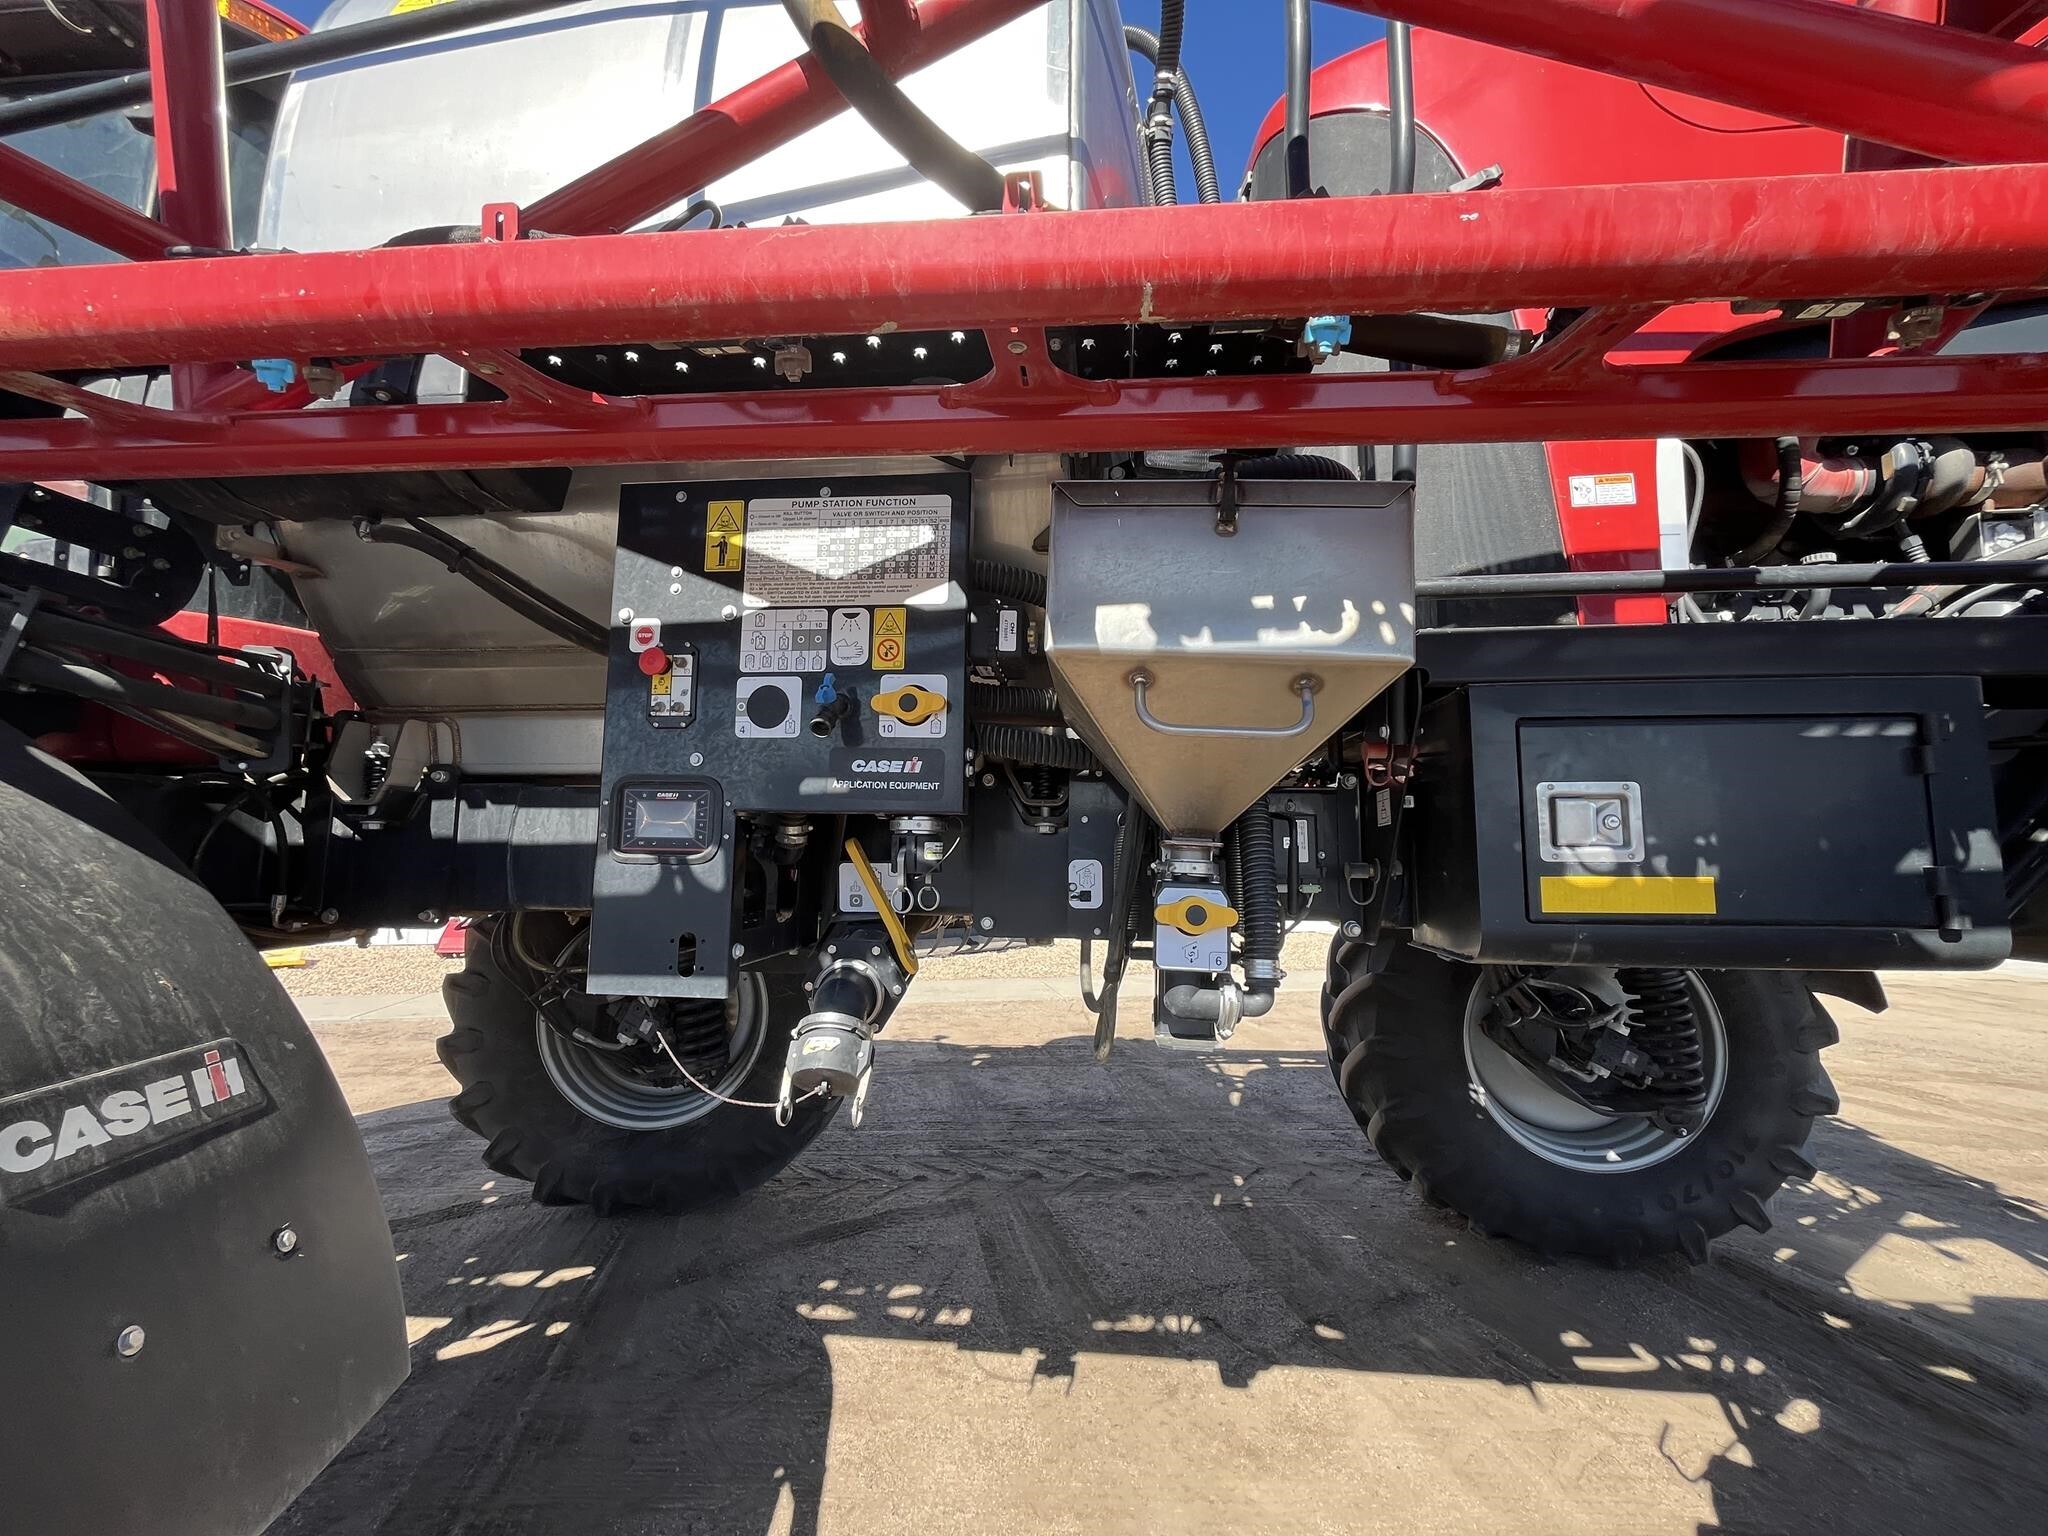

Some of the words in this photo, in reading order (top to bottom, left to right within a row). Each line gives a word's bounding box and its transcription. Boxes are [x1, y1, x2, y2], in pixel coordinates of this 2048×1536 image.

[792, 500, 820, 508] PUMP
[822, 499, 863, 508] STATION
[865, 498, 916, 506] FUNCTION
[739, 726, 746, 734] 4
[881, 725, 893, 734] 10
[851, 759, 904, 773] CASE
[832, 780, 888, 789] APPLICATION
[889, 781, 940, 790] EQUIPMENT
[1215, 956, 1222, 966] 6
[0, 1075, 193, 1173] CASE
